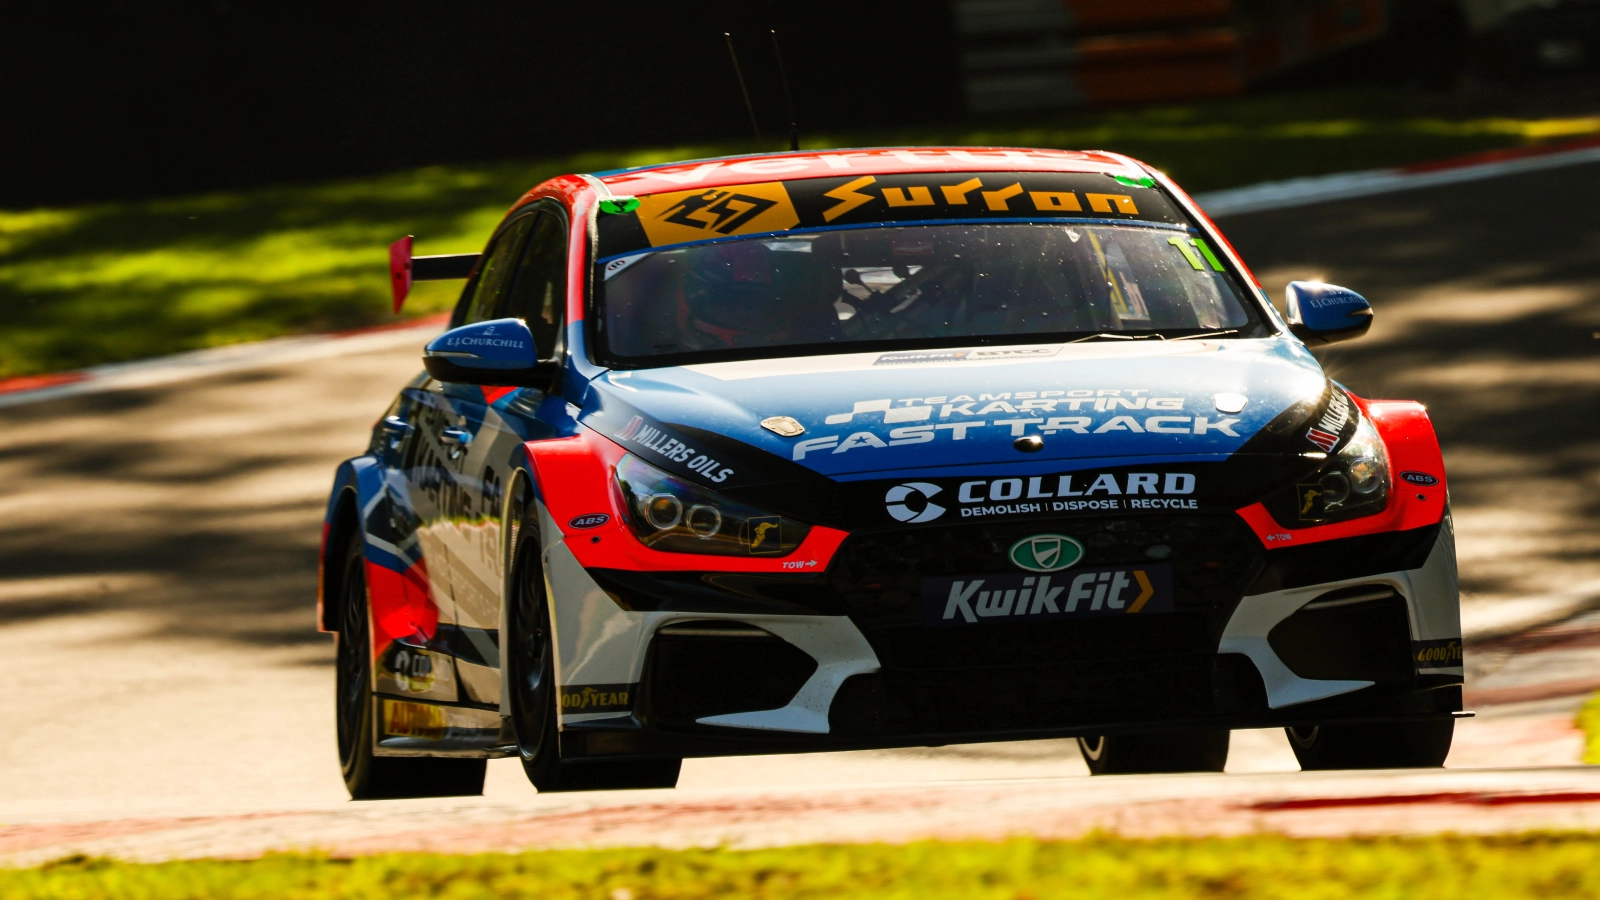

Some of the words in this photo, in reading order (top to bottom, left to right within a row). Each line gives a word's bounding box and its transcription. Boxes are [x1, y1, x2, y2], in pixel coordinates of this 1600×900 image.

[1167, 237, 1226, 272] 11
[897, 388, 1150, 406] TEAMSPORT
[939, 397, 1186, 417] KARTING
[792, 420, 986, 461] FAST
[998, 415, 1241, 437] TRACK
[633, 424, 690, 463] MILLERS
[686, 454, 735, 484] OILS
[957, 472, 1197, 504] COLLARD
[1406, 474, 1434, 483] ABS
[960, 502, 1041, 518] DEMOLISH
[1053, 499, 1119, 511] DISPOSE
[1131, 498, 1199, 510] RECYCLE
[574, 515, 605, 526] ABS
[1275, 533, 1293, 541] TOW
[782, 560, 805, 569] TOW
[942, 570, 1131, 623] KwikFit
[1417, 645, 1462, 661] GOODYE
[561, 690, 629, 708] ODYEAR
